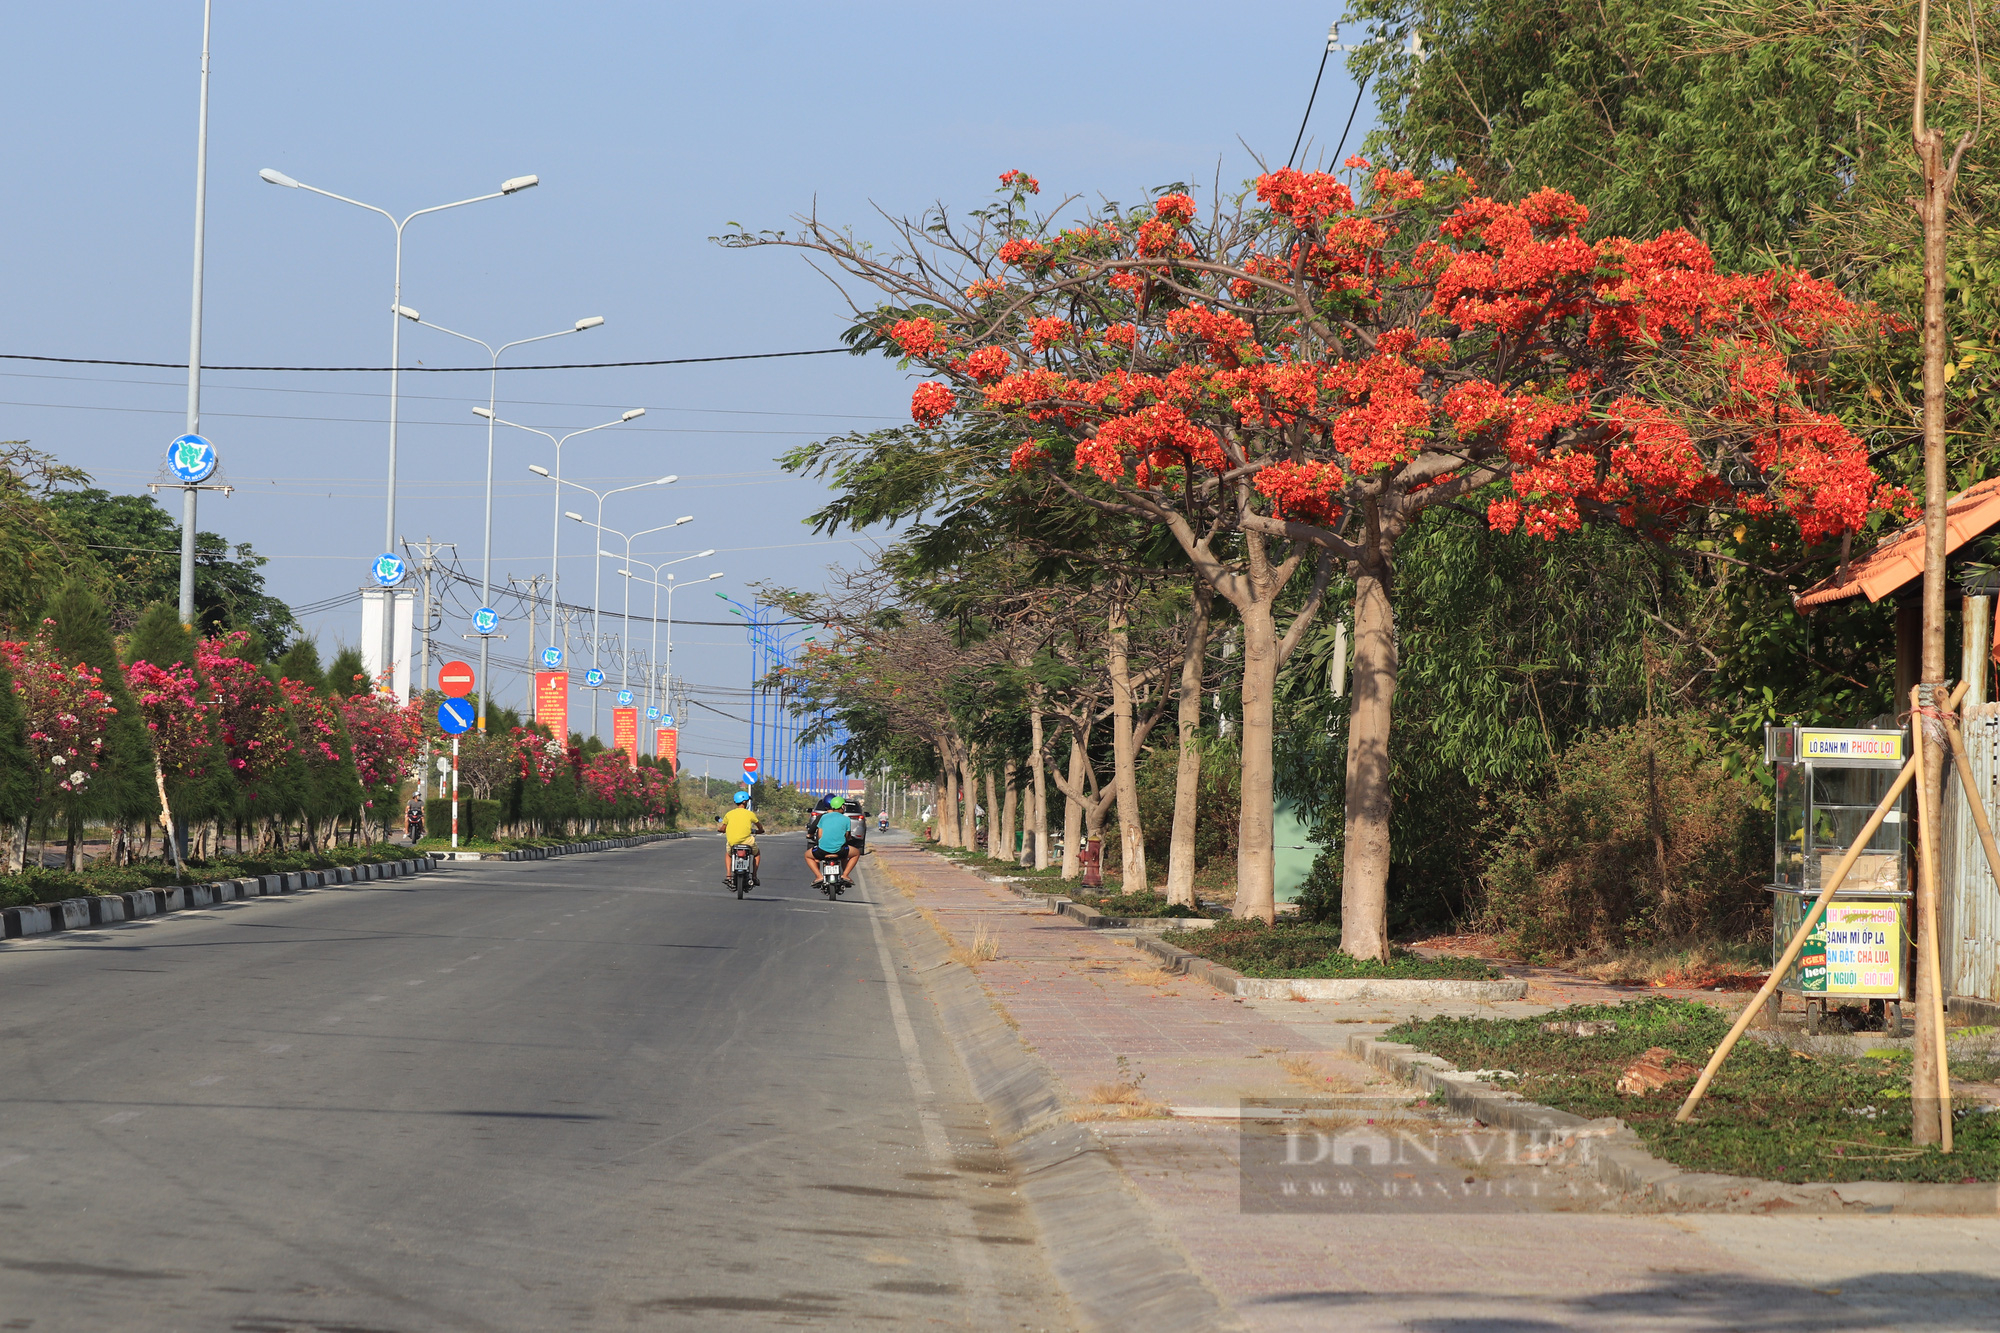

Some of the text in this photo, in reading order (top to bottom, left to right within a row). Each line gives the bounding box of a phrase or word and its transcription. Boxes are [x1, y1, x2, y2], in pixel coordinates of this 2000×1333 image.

[1820, 739, 1838, 753] BÁNH
[1840, 740, 1849, 754] MÌ
[1852, 737, 1878, 754] PHƯỚC
[1850, 928, 1860, 944] MÌ
[1875, 931, 1885, 945] LA
[1857, 946, 1873, 963] CHẢ
[1875, 950, 1889, 966] LỤA
[1805, 967, 1826, 978] heo
